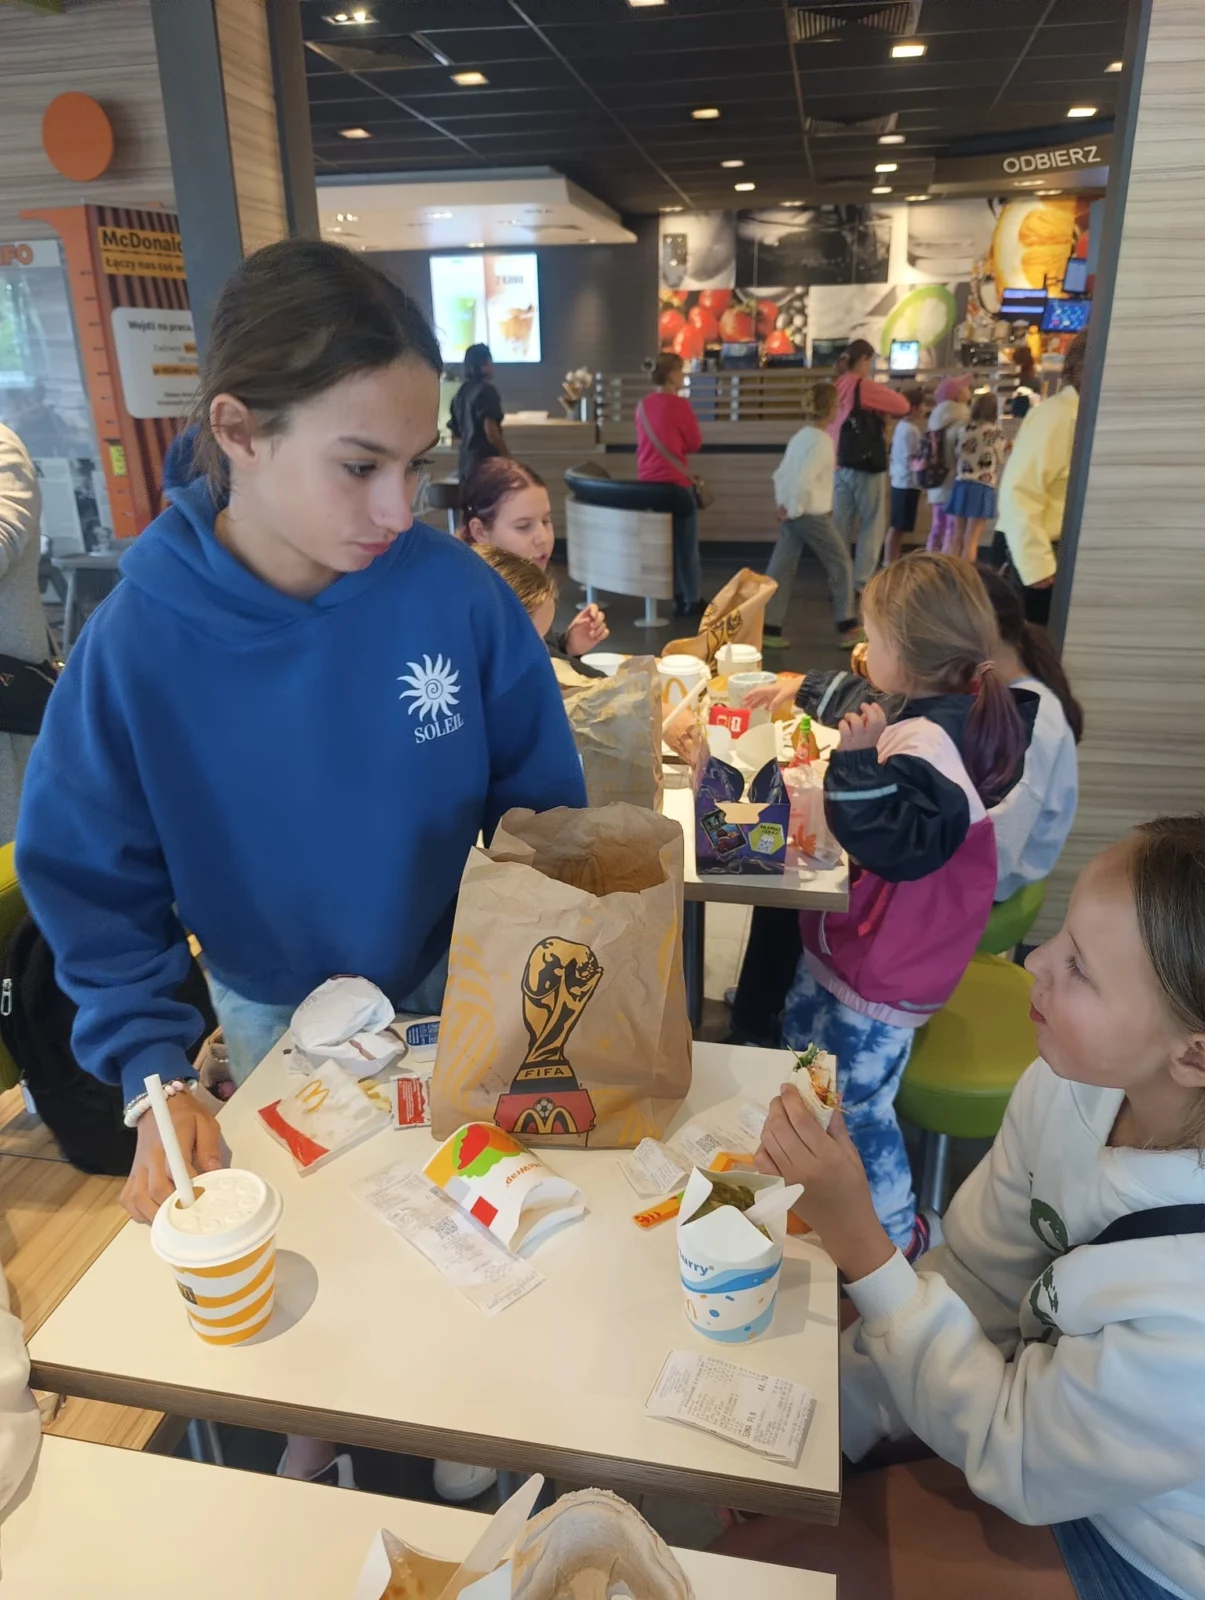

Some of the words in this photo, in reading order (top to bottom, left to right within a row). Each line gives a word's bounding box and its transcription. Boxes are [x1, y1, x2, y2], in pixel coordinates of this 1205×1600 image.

[1002, 145, 1101, 174] ODBIERZ
[413, 713, 464, 744] SOLEIL
[524, 1067, 565, 1078] FIFA
